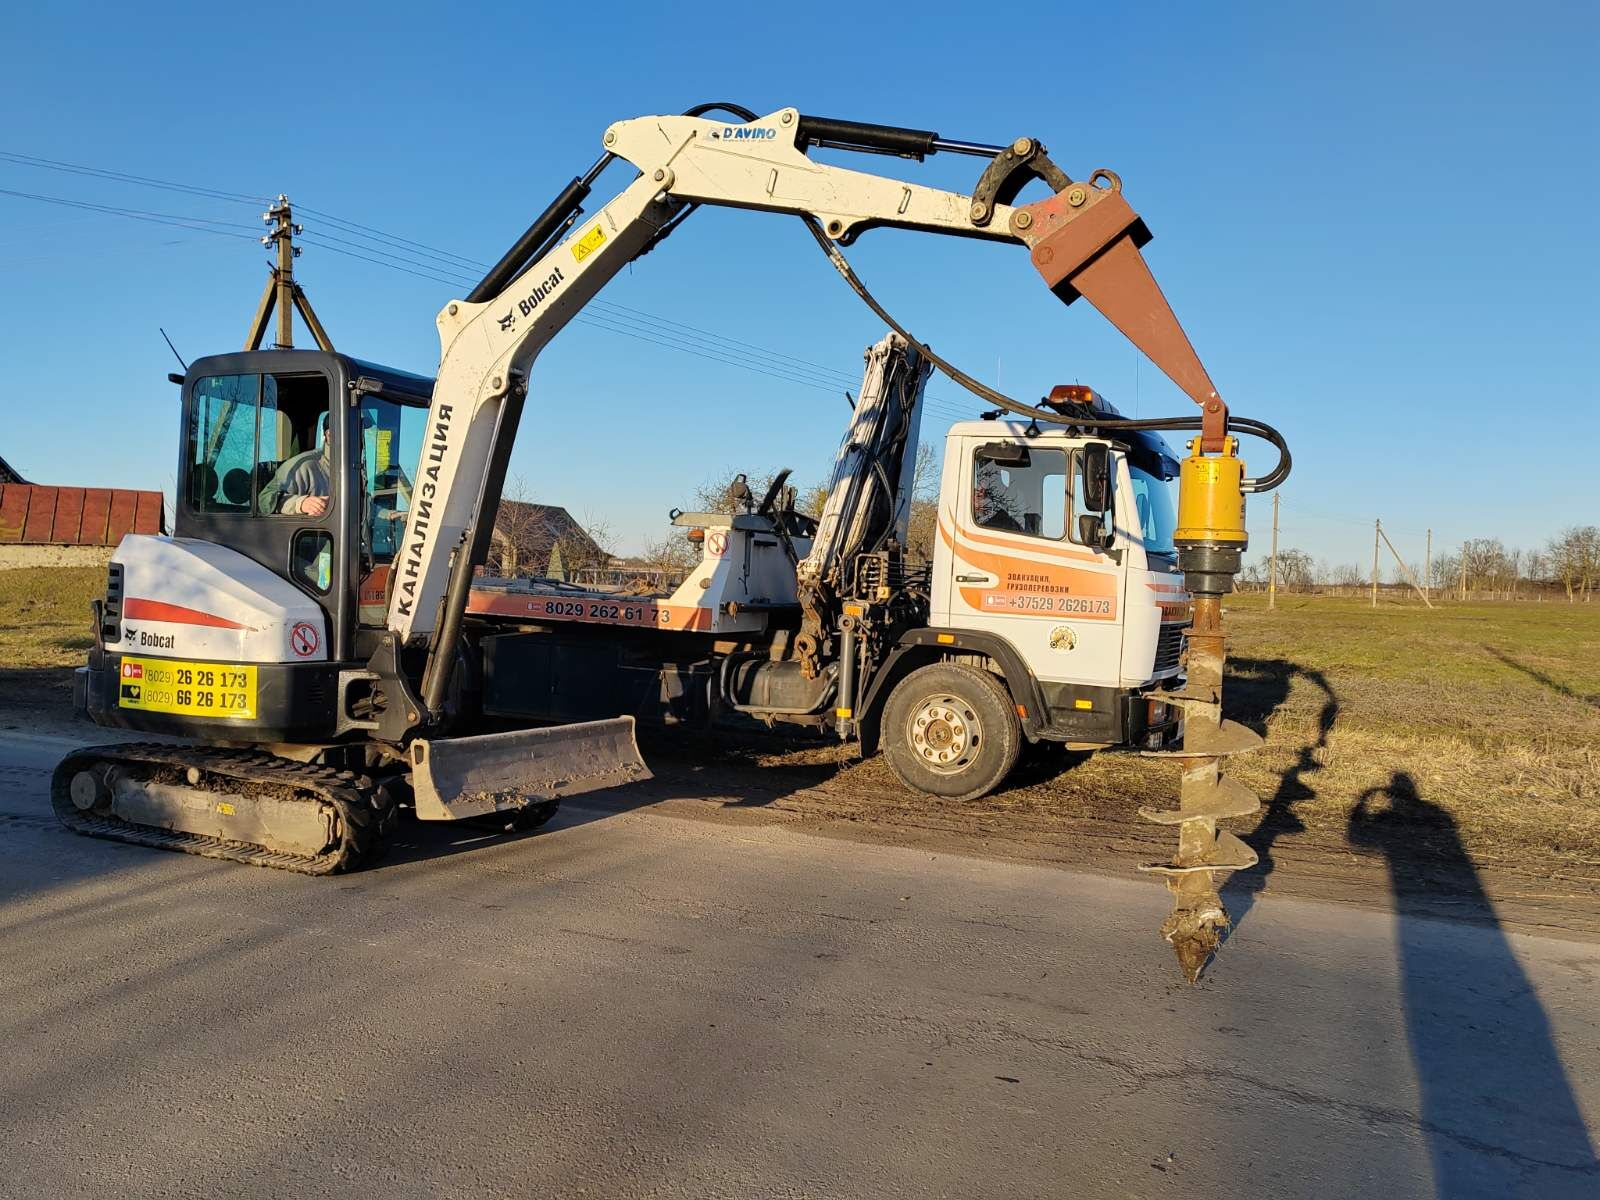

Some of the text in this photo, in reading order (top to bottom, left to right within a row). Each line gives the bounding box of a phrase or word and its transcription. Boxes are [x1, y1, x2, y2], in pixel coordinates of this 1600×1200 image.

[518, 266, 565, 317] Bobcat
[397, 404, 453, 616] КАНАЛИЗАЦИЯ
[545, 601, 584, 616] 8029
[590, 604, 619, 619] 262
[624, 607, 643, 621] 61
[1009, 595, 1110, 613] +37529 2626173
[140, 631, 175, 649] Bobcat
[144, 669, 174, 686] (8029)
[177, 669, 192, 685] 26
[197, 670, 214, 686] 26
[220, 672, 247, 688] 173
[143, 689, 247, 709] (8029) 66 26 173
